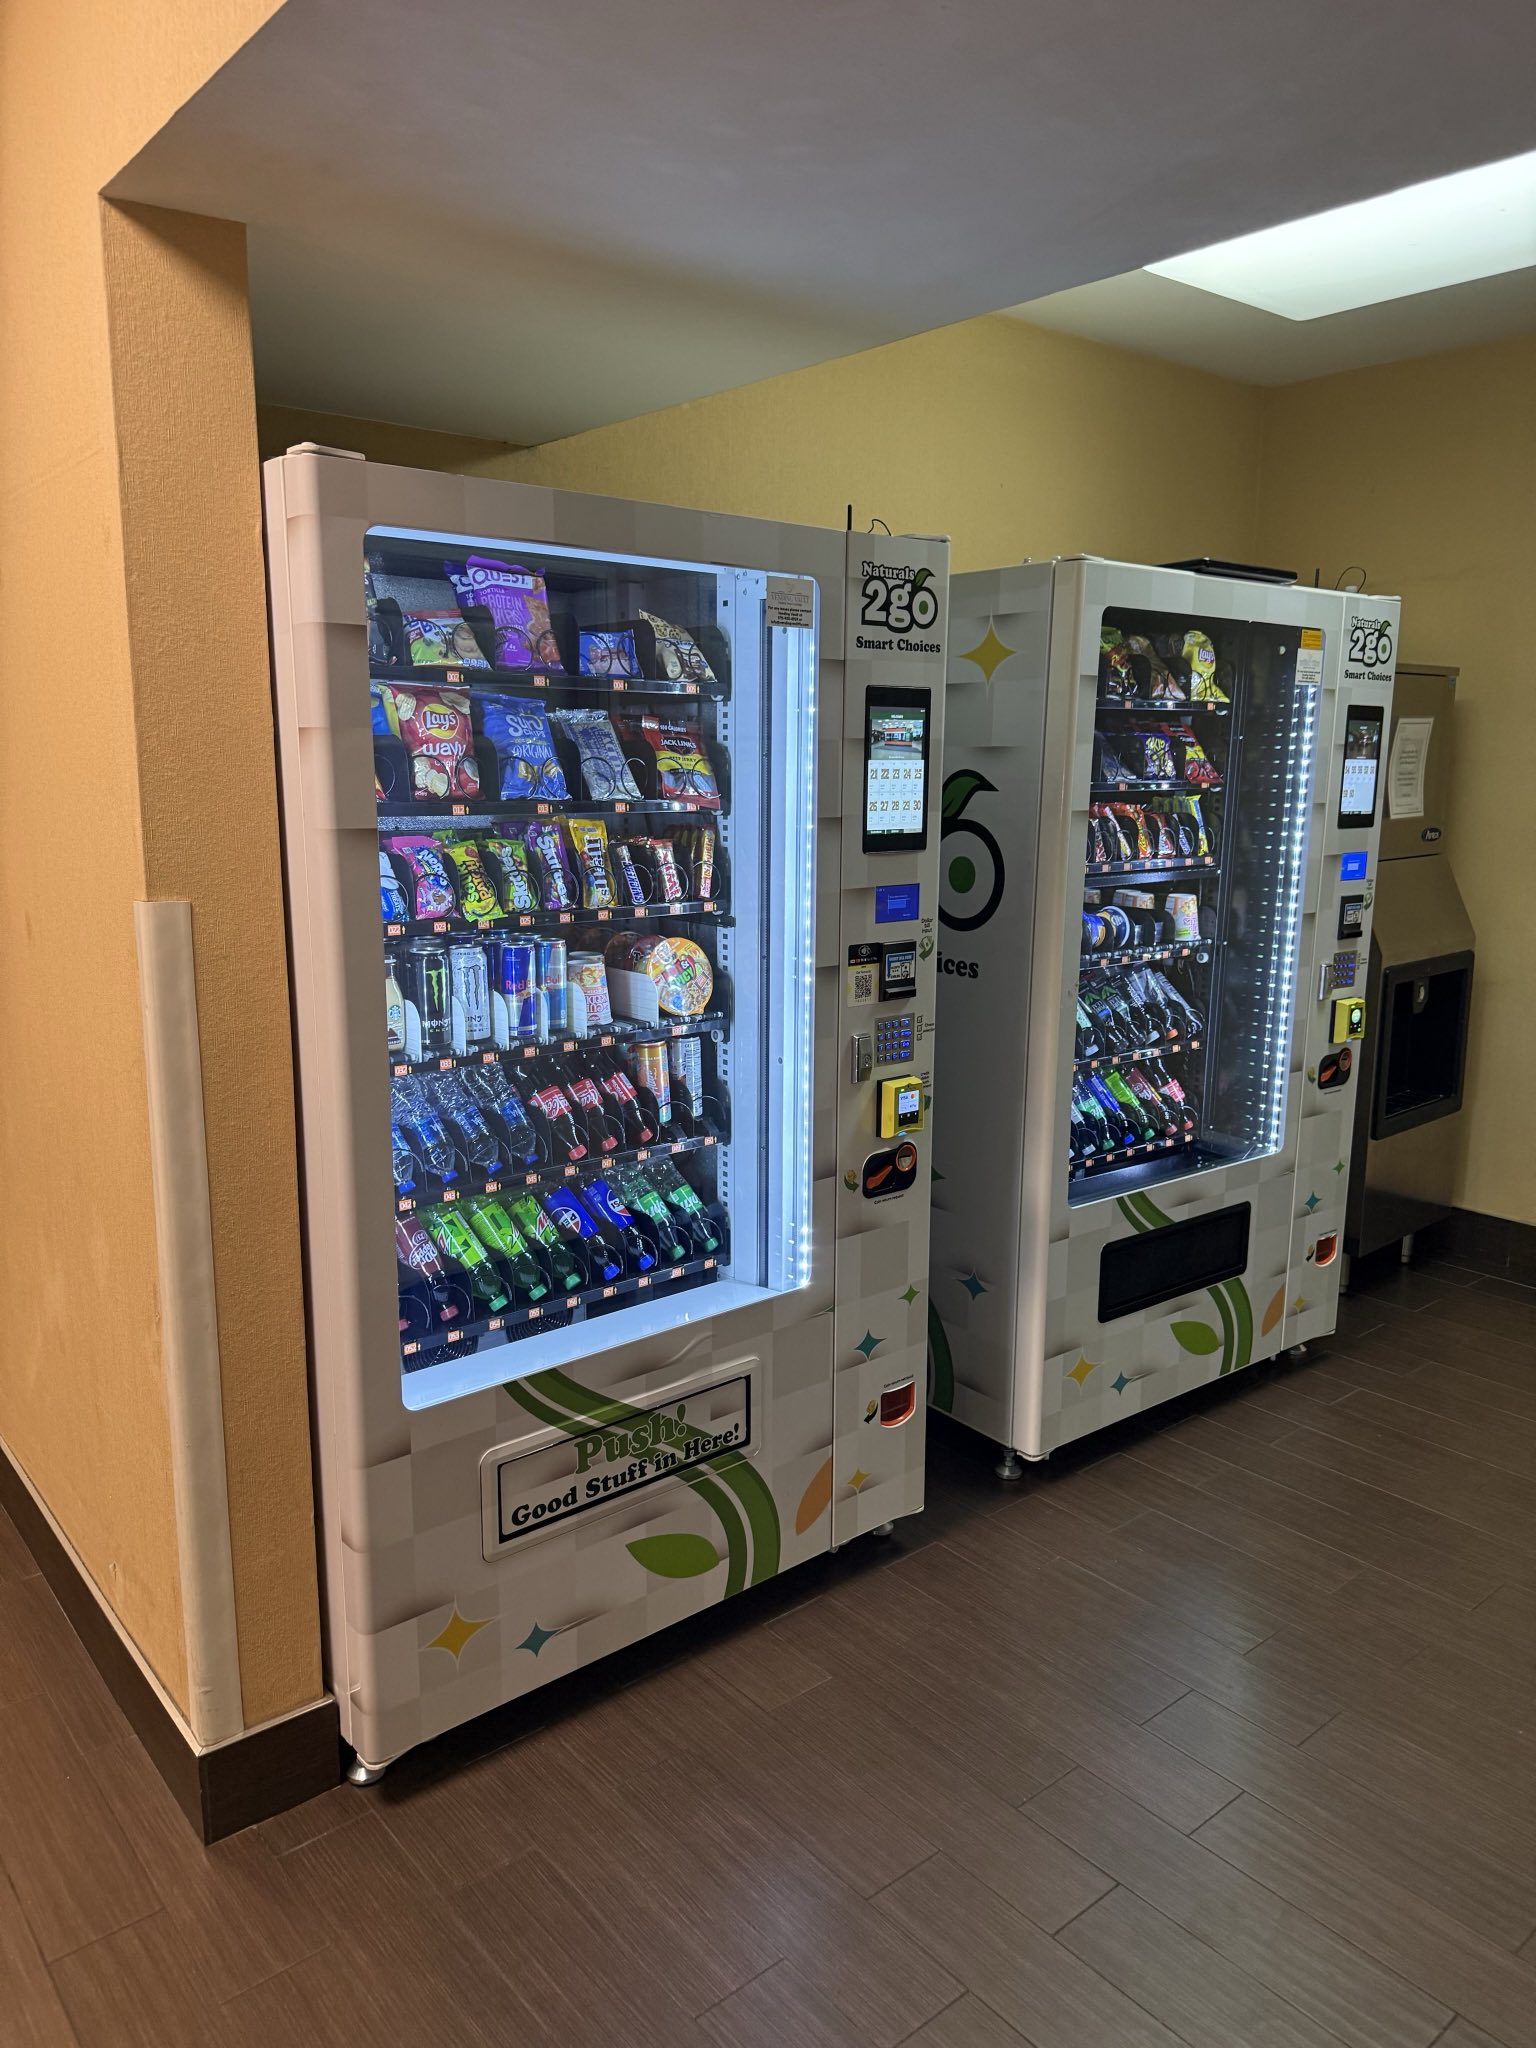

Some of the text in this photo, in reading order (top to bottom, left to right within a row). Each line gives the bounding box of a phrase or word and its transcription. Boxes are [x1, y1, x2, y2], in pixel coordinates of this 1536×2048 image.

[862, 561, 915, 580] Naturals
[481, 594, 524, 612] PROTEIN
[861, 577, 938, 634] 2go
[491, 607, 523, 625] HIPS
[856, 636, 941, 653] Smart Choices
[1348, 627, 1392, 668] 2go
[1344, 669, 1392, 682] Smart Choices
[660, 739, 678, 747] JACK
[870, 768, 878, 780] 21
[881, 768, 890, 780] 22
[892, 768, 900, 780] 23
[903, 768, 912, 780] 24
[869, 801, 878, 812] 26
[880, 801, 889, 811] 27
[892, 801, 900, 811] 28
[913, 800, 921, 810] 30
[937, 951, 979, 979] ices
[574, 1403, 687, 1475] Push!
[511, 1423, 740, 1526] Good Stuff in Here!
